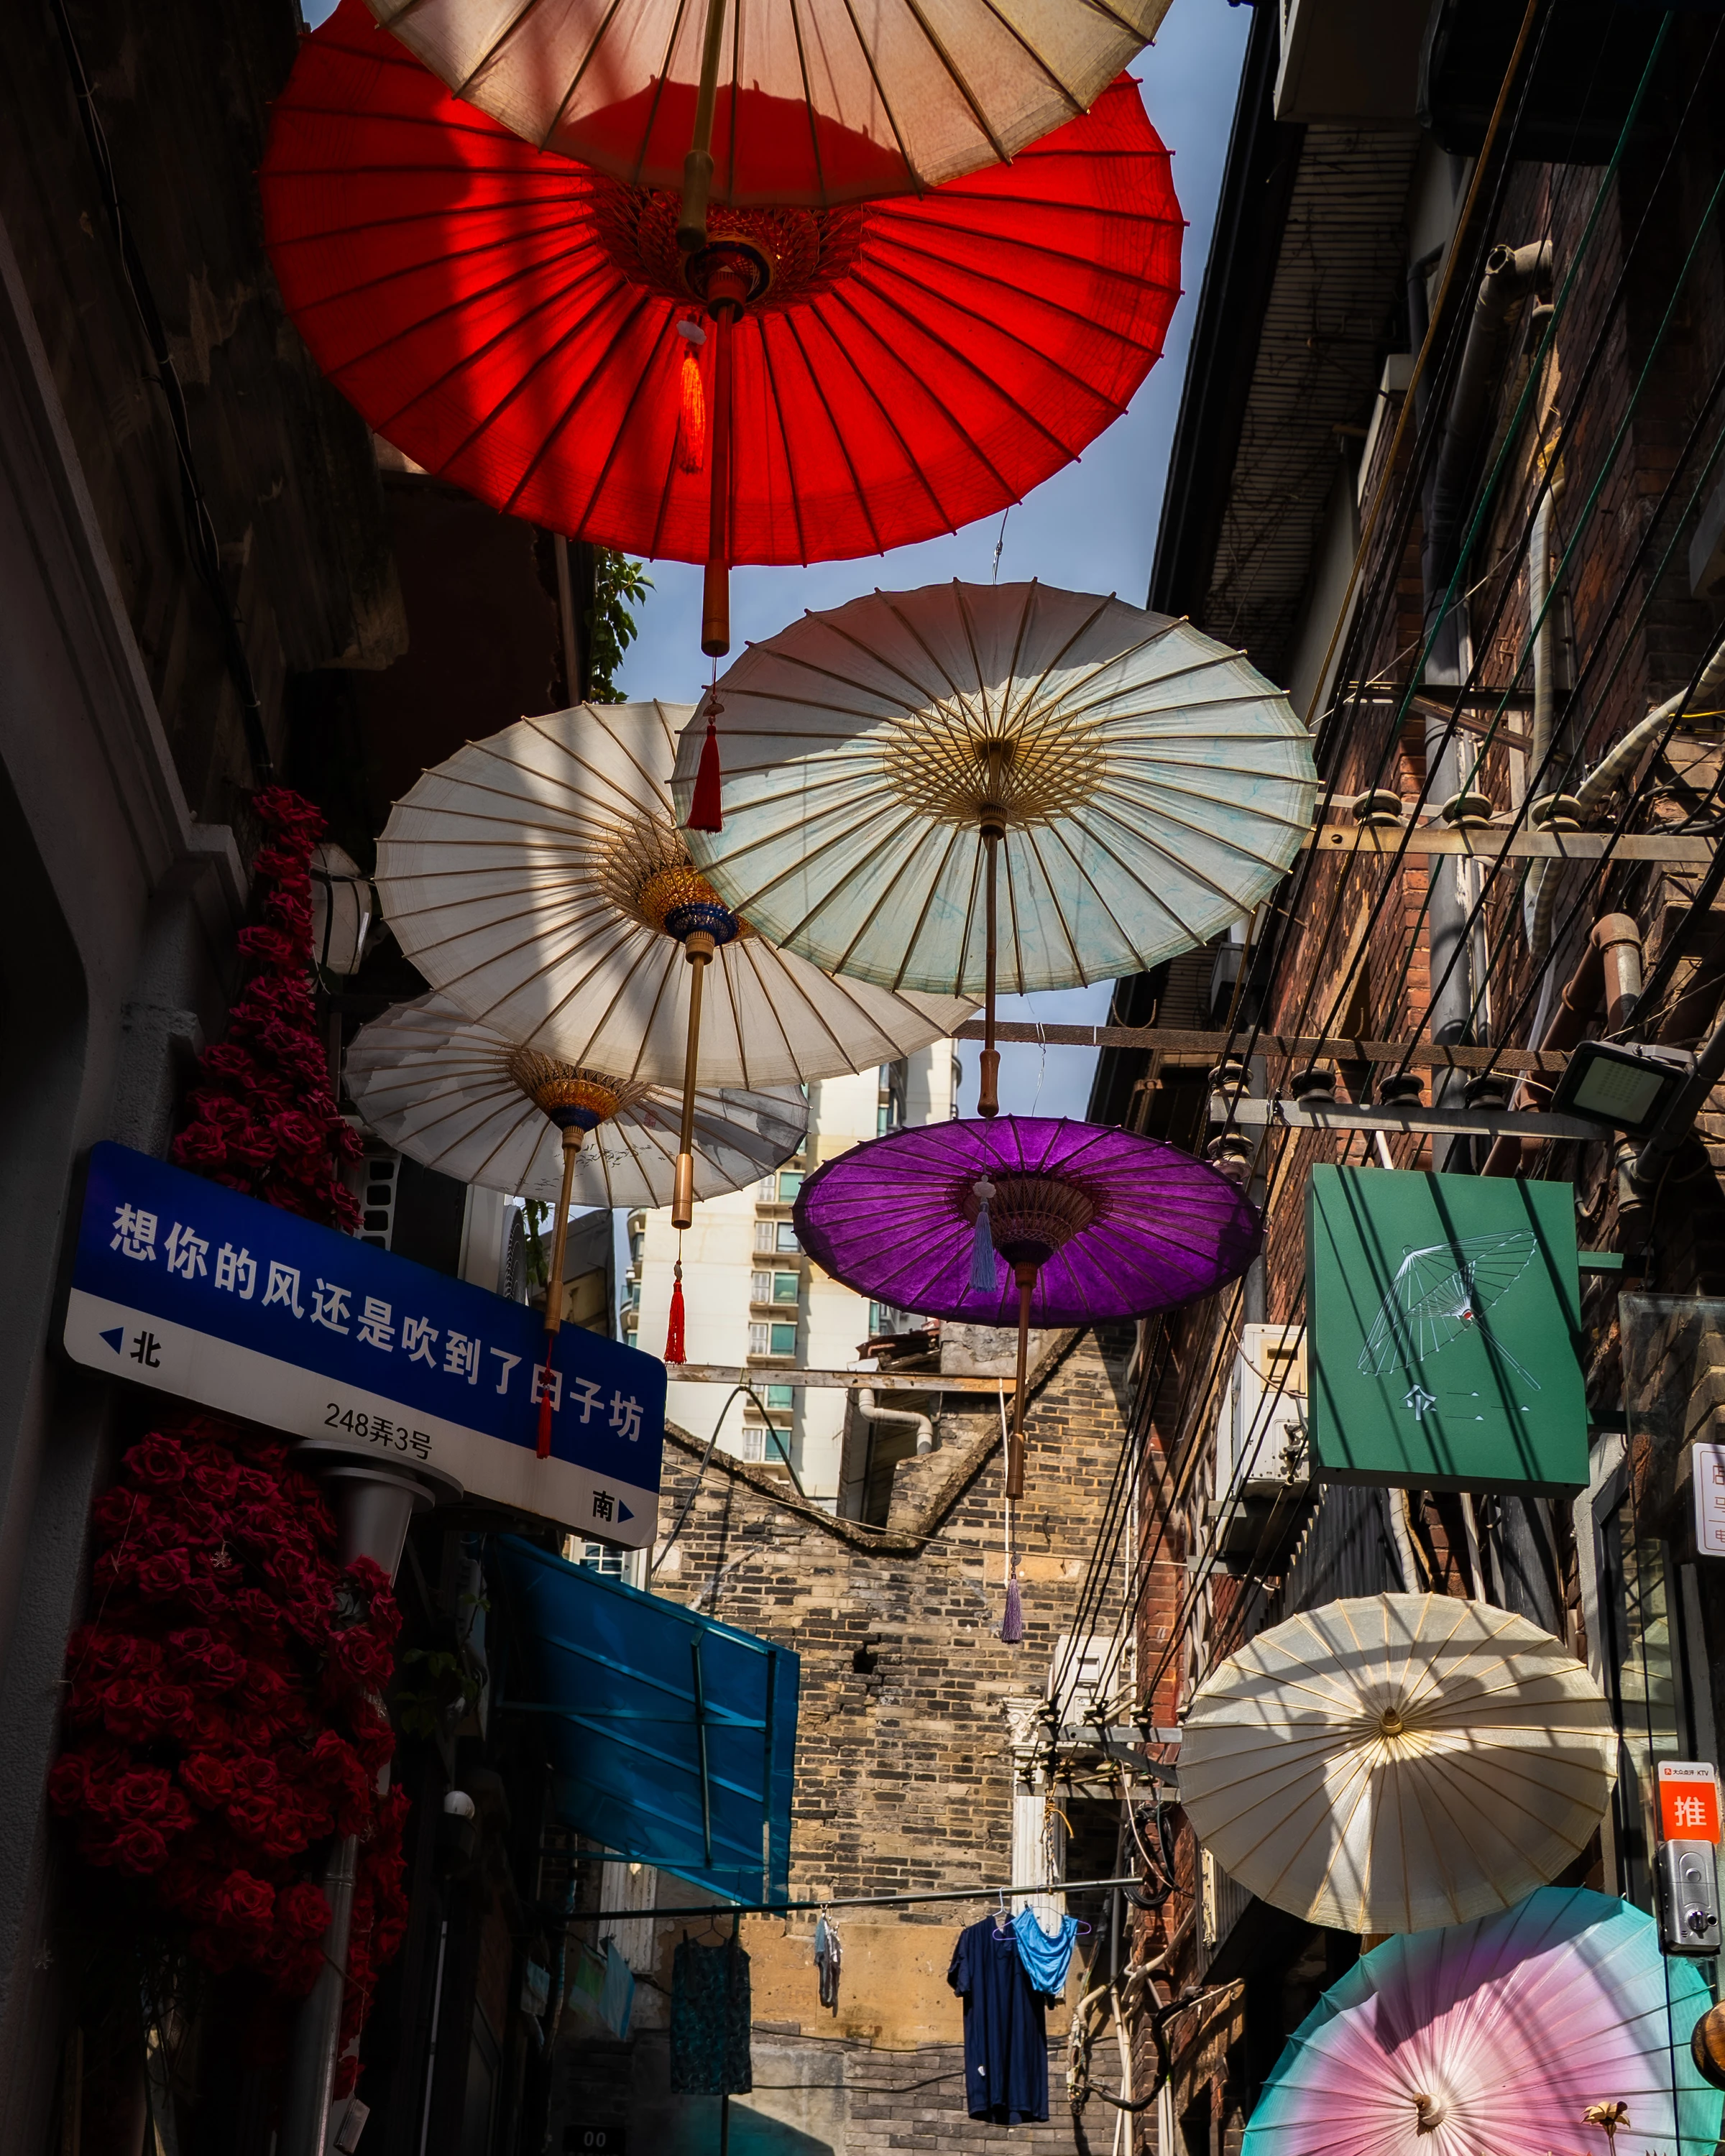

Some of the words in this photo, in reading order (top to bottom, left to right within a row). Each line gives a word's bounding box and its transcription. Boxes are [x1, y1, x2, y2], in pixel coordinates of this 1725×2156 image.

[110, 1202, 645, 1443] 想你的风还是吹到了田子坊
[130, 1329, 162, 1368] 北
[324, 1403, 433, 1460] 248弄3号
[592, 1490, 616, 1524] 南
[1673, 1795, 1707, 1828] 推
